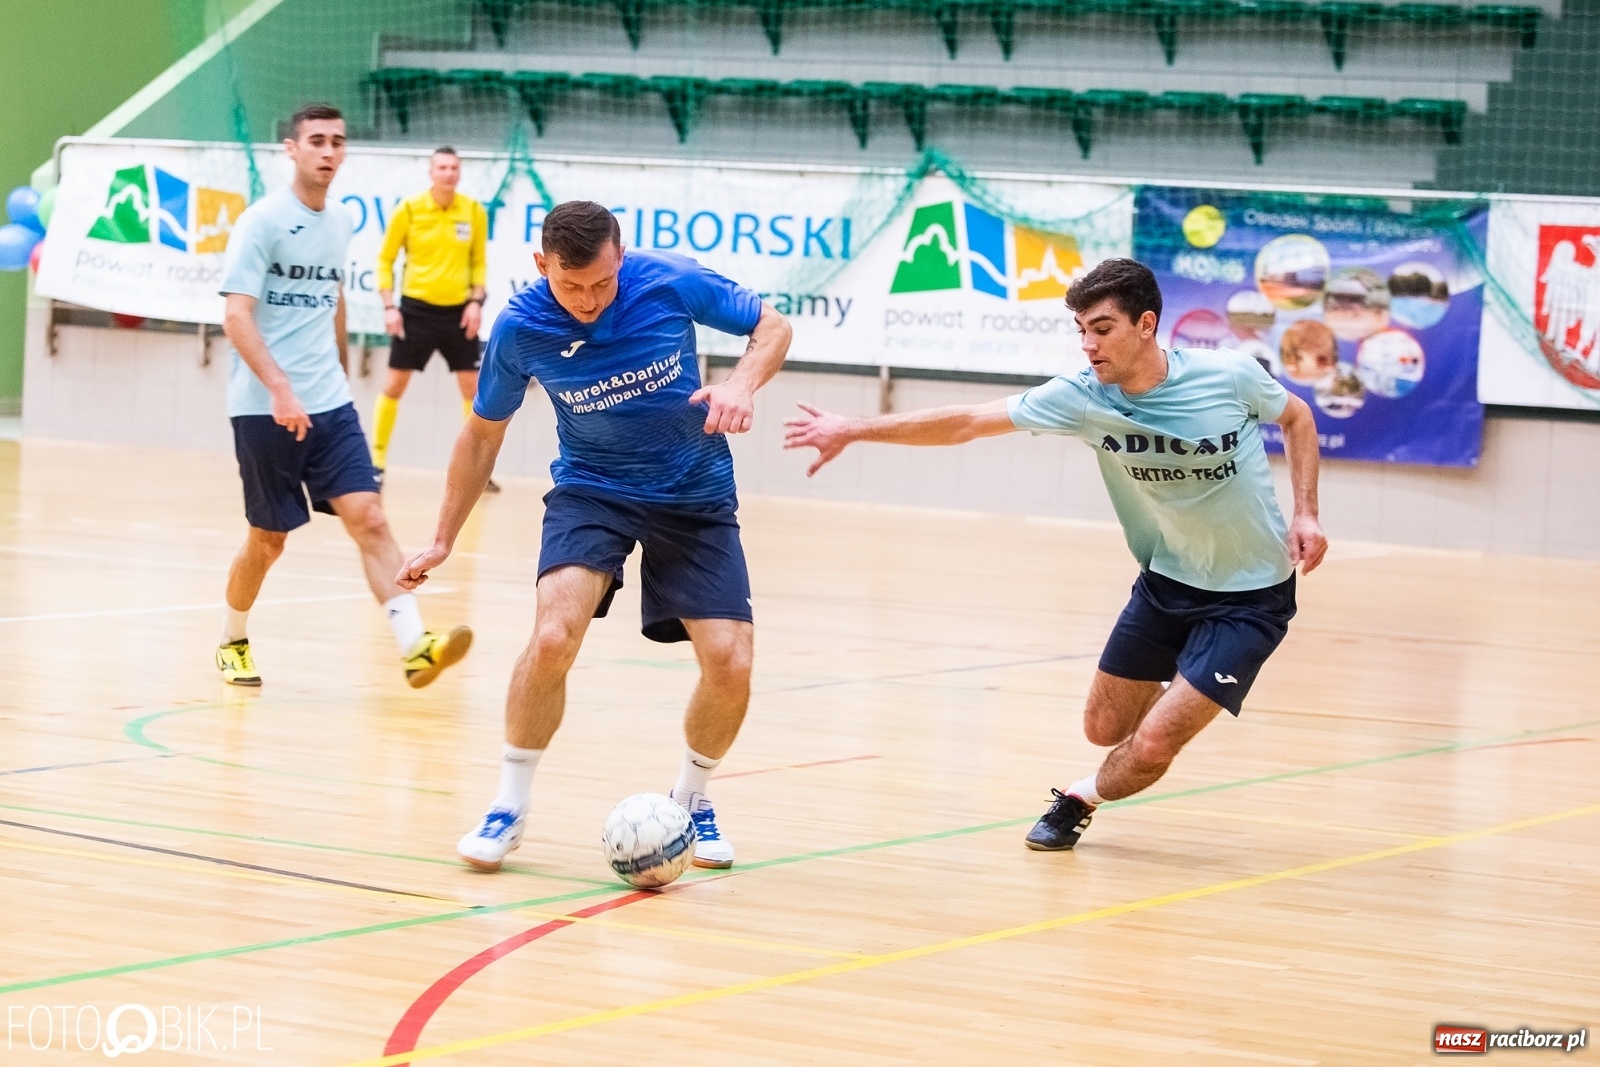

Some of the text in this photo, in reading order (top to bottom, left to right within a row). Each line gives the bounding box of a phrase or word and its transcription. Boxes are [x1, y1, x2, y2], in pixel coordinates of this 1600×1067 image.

[884, 307, 964, 331] powiat
[573, 388, 642, 414] Metallbau
[1101, 431, 1239, 456] ADICAR
